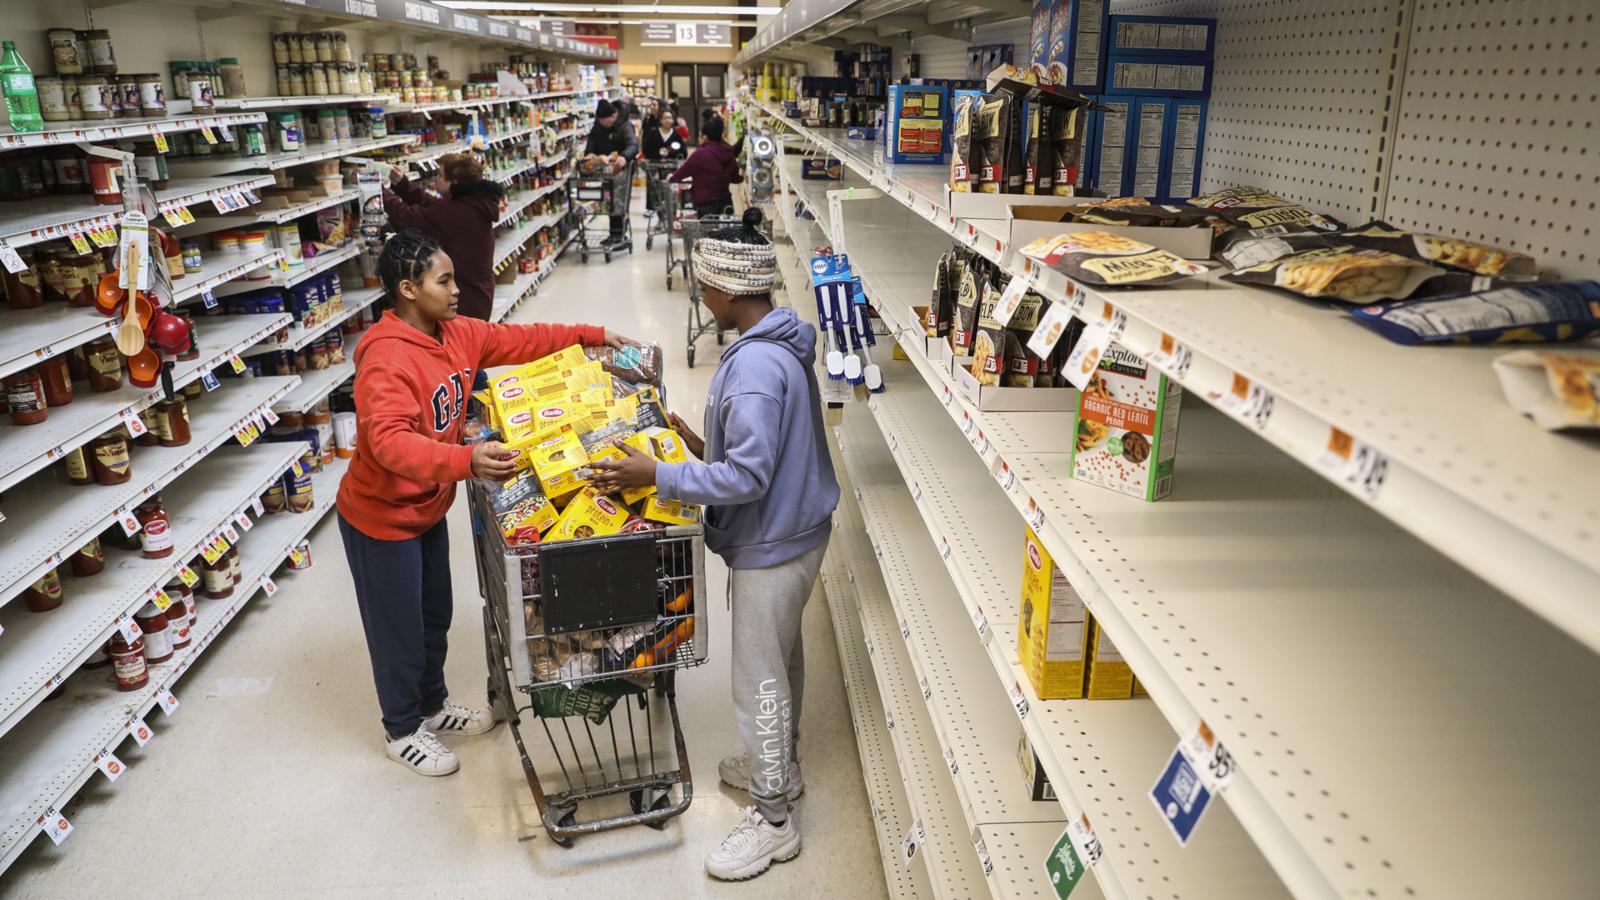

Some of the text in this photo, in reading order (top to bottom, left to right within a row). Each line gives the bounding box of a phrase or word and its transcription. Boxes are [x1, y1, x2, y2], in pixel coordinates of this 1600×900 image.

[680, 28, 693, 40] 13
[1102, 253, 1177, 273] ELBOW
[1111, 363, 1145, 376] CUISINE
[431, 367, 471, 432] GA
[1084, 399, 1111, 415] ORGANIC
[1127, 411, 1149, 426] LENTIL
[1106, 416, 1124, 428] PENNE
[577, 688, 592, 710] FOR
[755, 679, 778, 735] Klein
